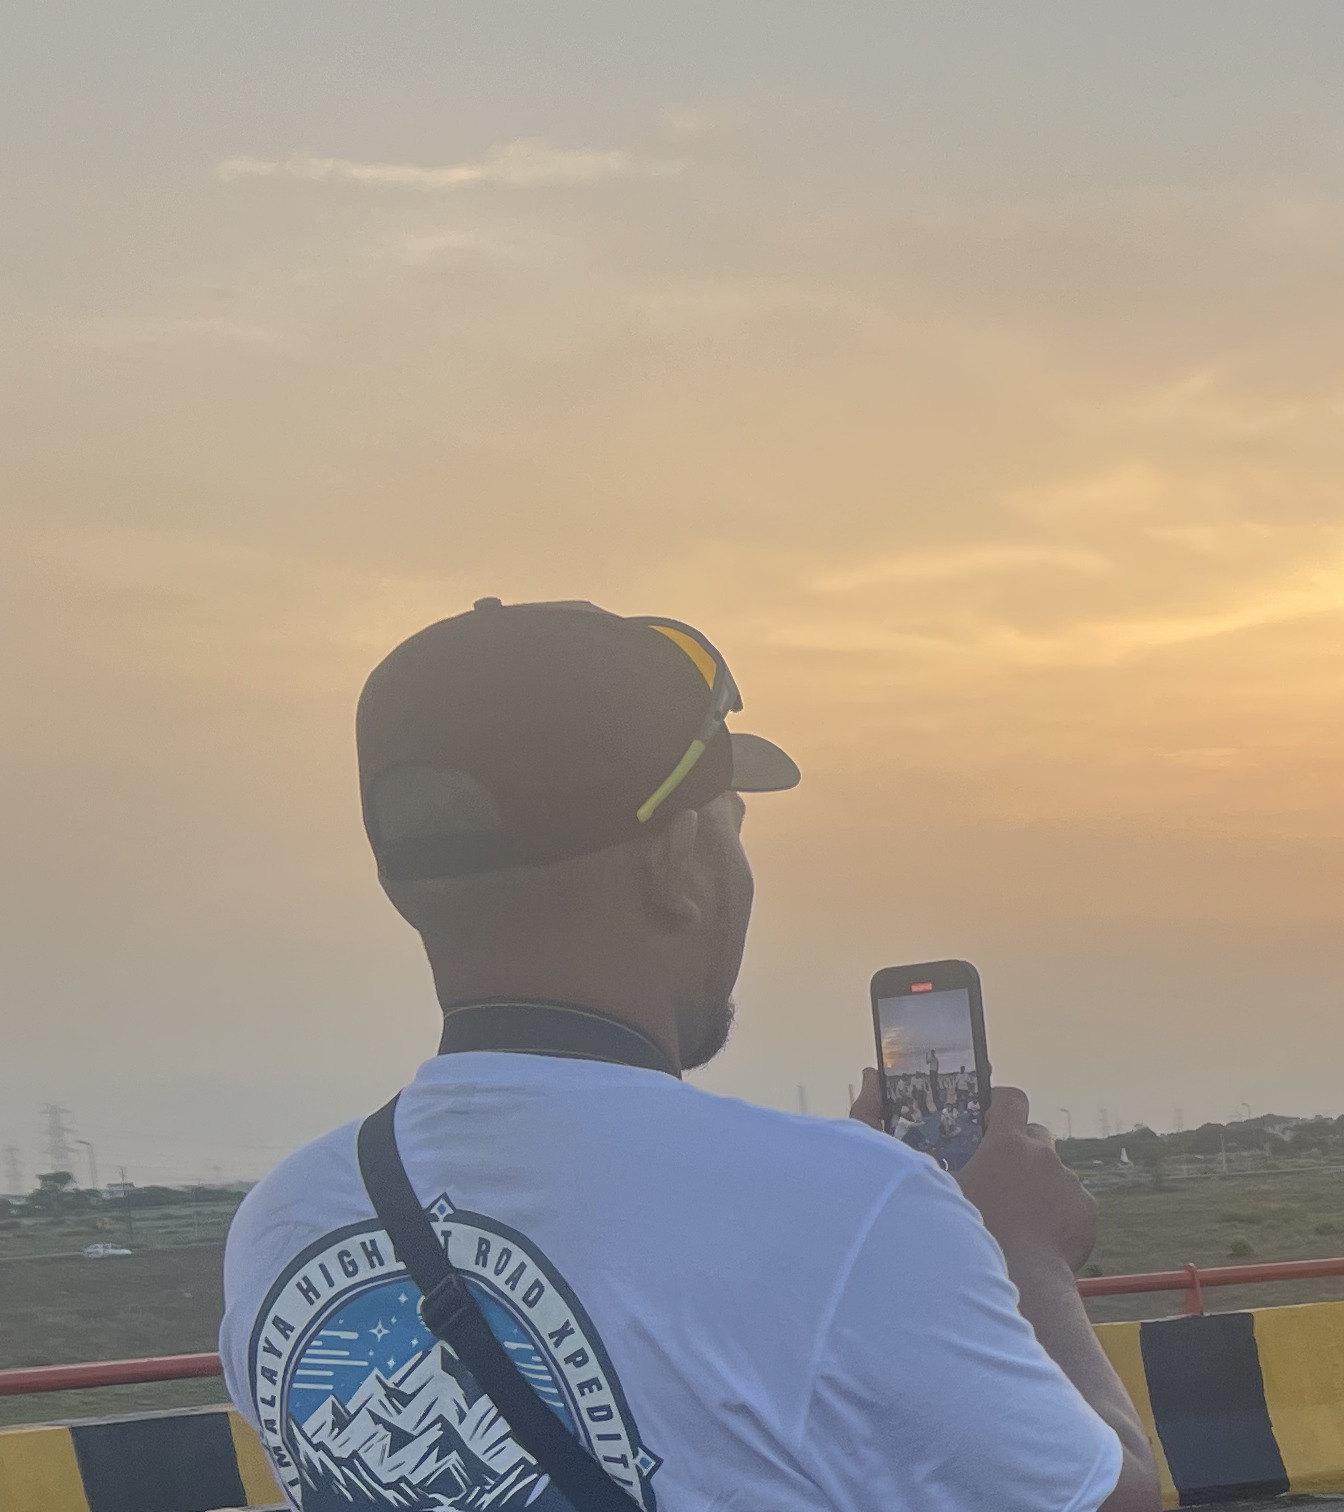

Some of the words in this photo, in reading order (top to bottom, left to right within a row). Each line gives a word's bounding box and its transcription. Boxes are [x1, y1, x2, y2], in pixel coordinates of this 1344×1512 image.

[259, 1314, 299, 1488] IMALAYA
[295, 1229, 453, 1307] HIGHT
[474, 1237, 544, 1310] ROAD
